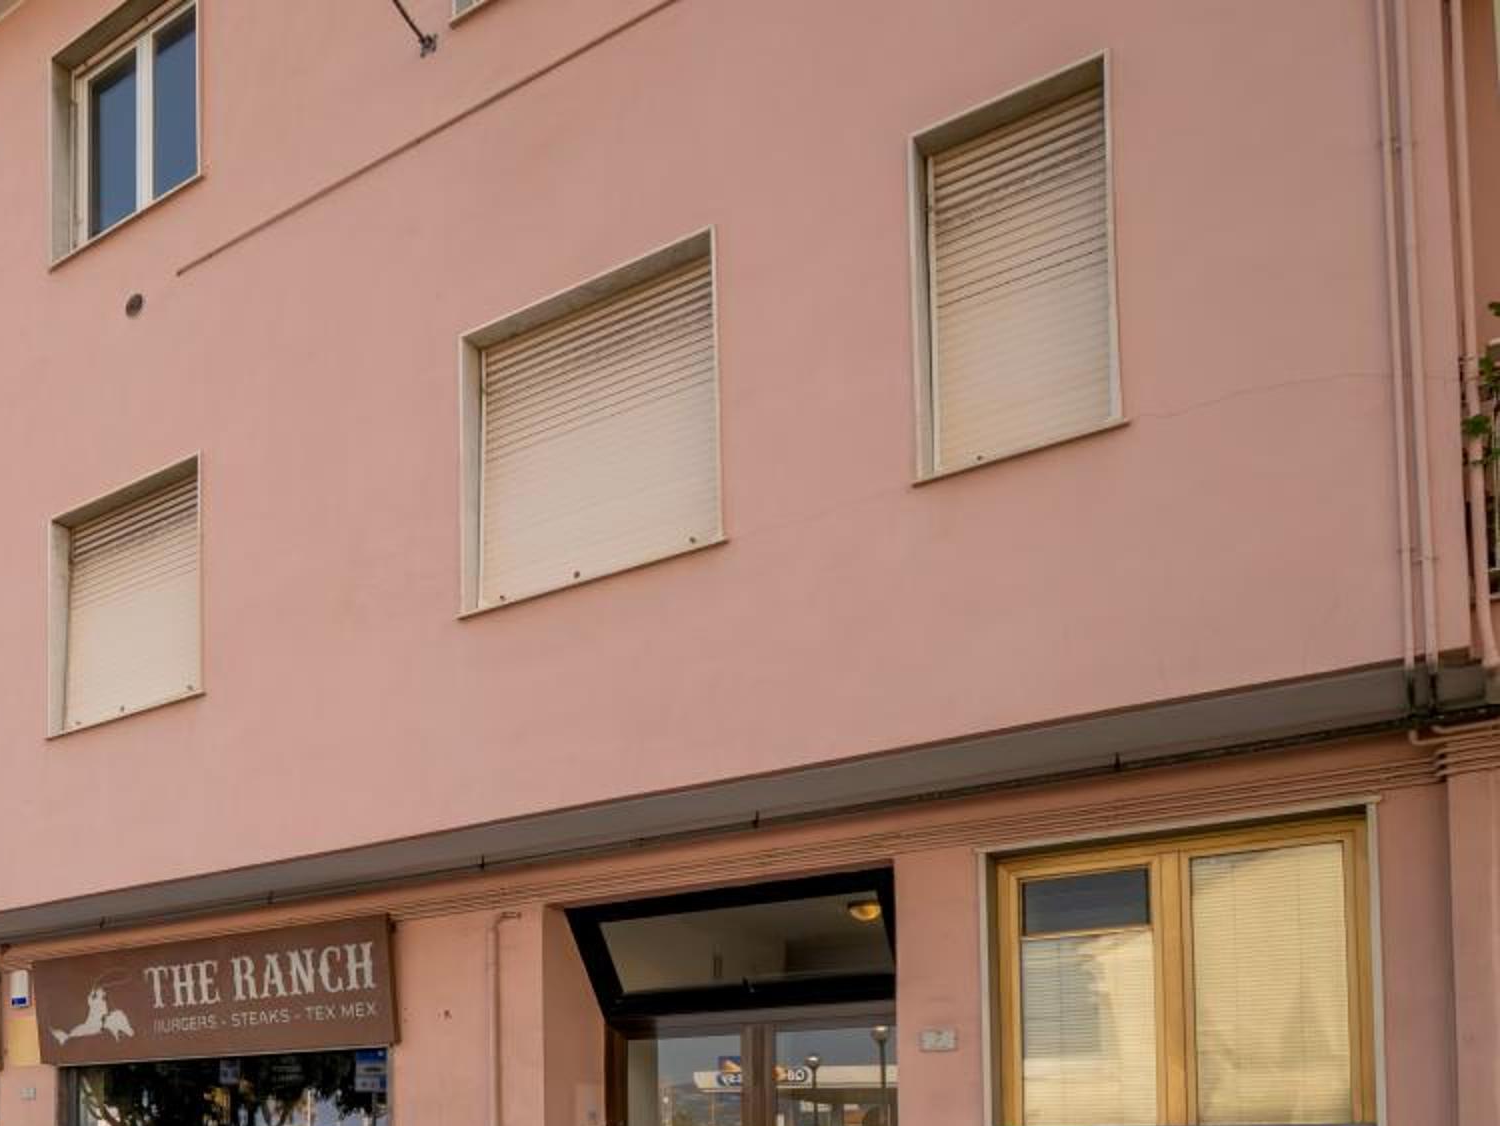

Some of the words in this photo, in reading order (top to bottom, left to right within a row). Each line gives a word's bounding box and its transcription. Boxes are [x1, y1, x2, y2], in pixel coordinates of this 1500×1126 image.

[144, 960, 221, 1009] THE
[230, 941, 376, 1001] RANCH
[231, 1009, 290, 1028] STEAKS
[305, 1004, 336, 1022] TEX
[341, 1001, 377, 1018] MEX
